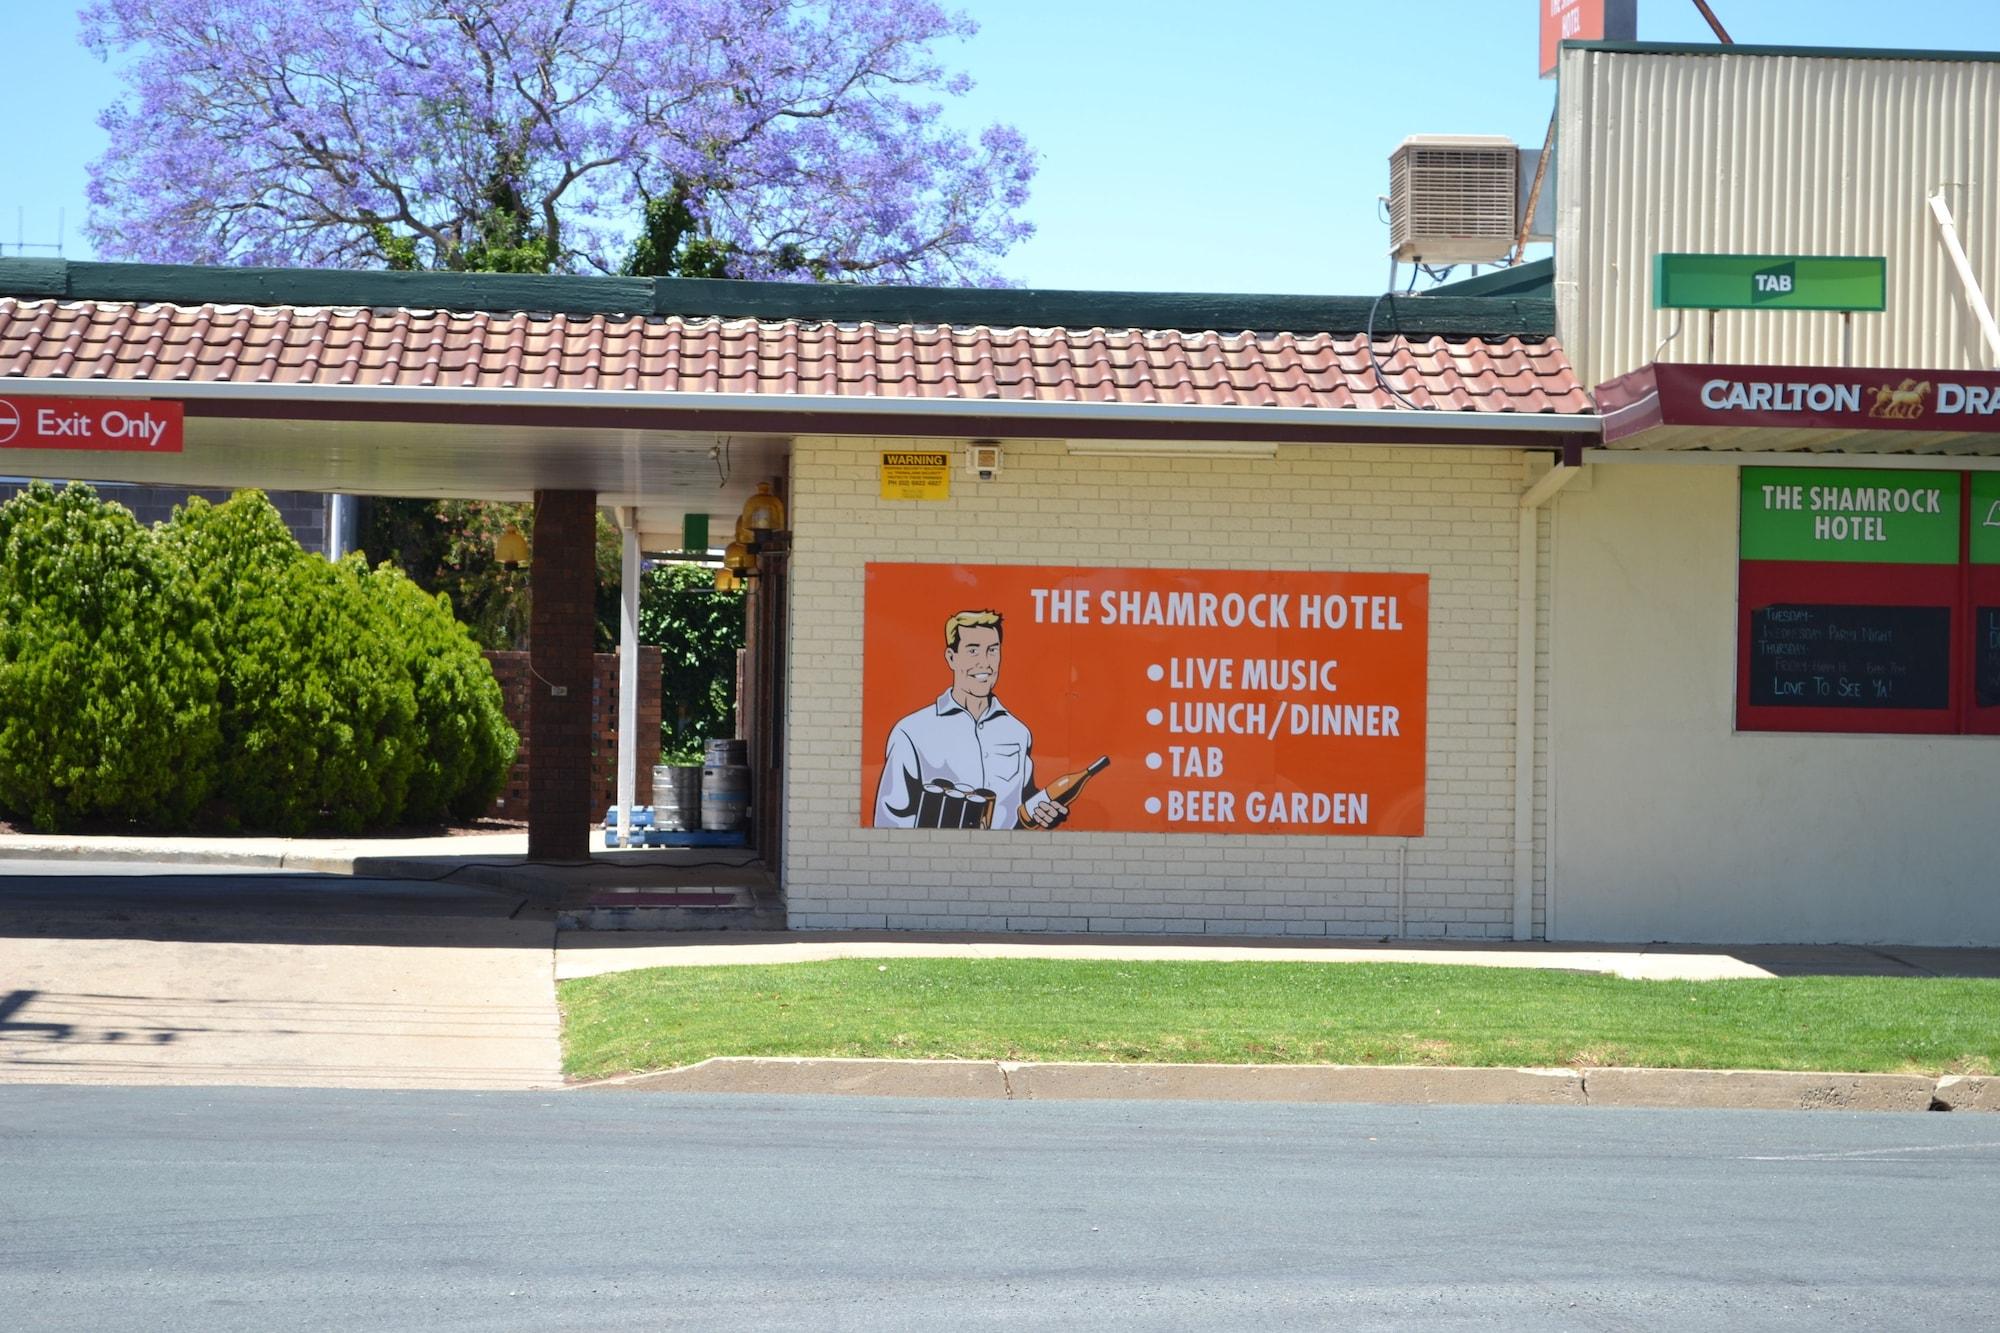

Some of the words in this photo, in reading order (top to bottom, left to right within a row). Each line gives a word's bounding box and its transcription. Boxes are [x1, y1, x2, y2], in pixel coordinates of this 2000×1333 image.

[1756, 275, 1791, 291] TAB
[1701, 380, 1860, 411] CARLTON
[38, 409, 91, 436] Exit
[101, 411, 166, 445] Only
[887, 455, 943, 465] WARNING
[1763, 486, 1802, 509] THE
[1810, 487, 1940, 512] SHAMROCK
[1816, 516, 1886, 540] HOTEL
[1031, 589, 1090, 623] THE
[1101, 590, 1289, 628] SHAMROCK
[1300, 595, 1402, 630] HOTEL
[1171, 658, 1233, 689] LIVE
[1241, 659, 1337, 691] MUSIC
[1170, 702, 1399, 740] LUNCH/DINNER
[1169, 746, 1223, 777] TAB
[1168, 791, 1235, 822] BEER
[1246, 792, 1367, 824] GARDEN
